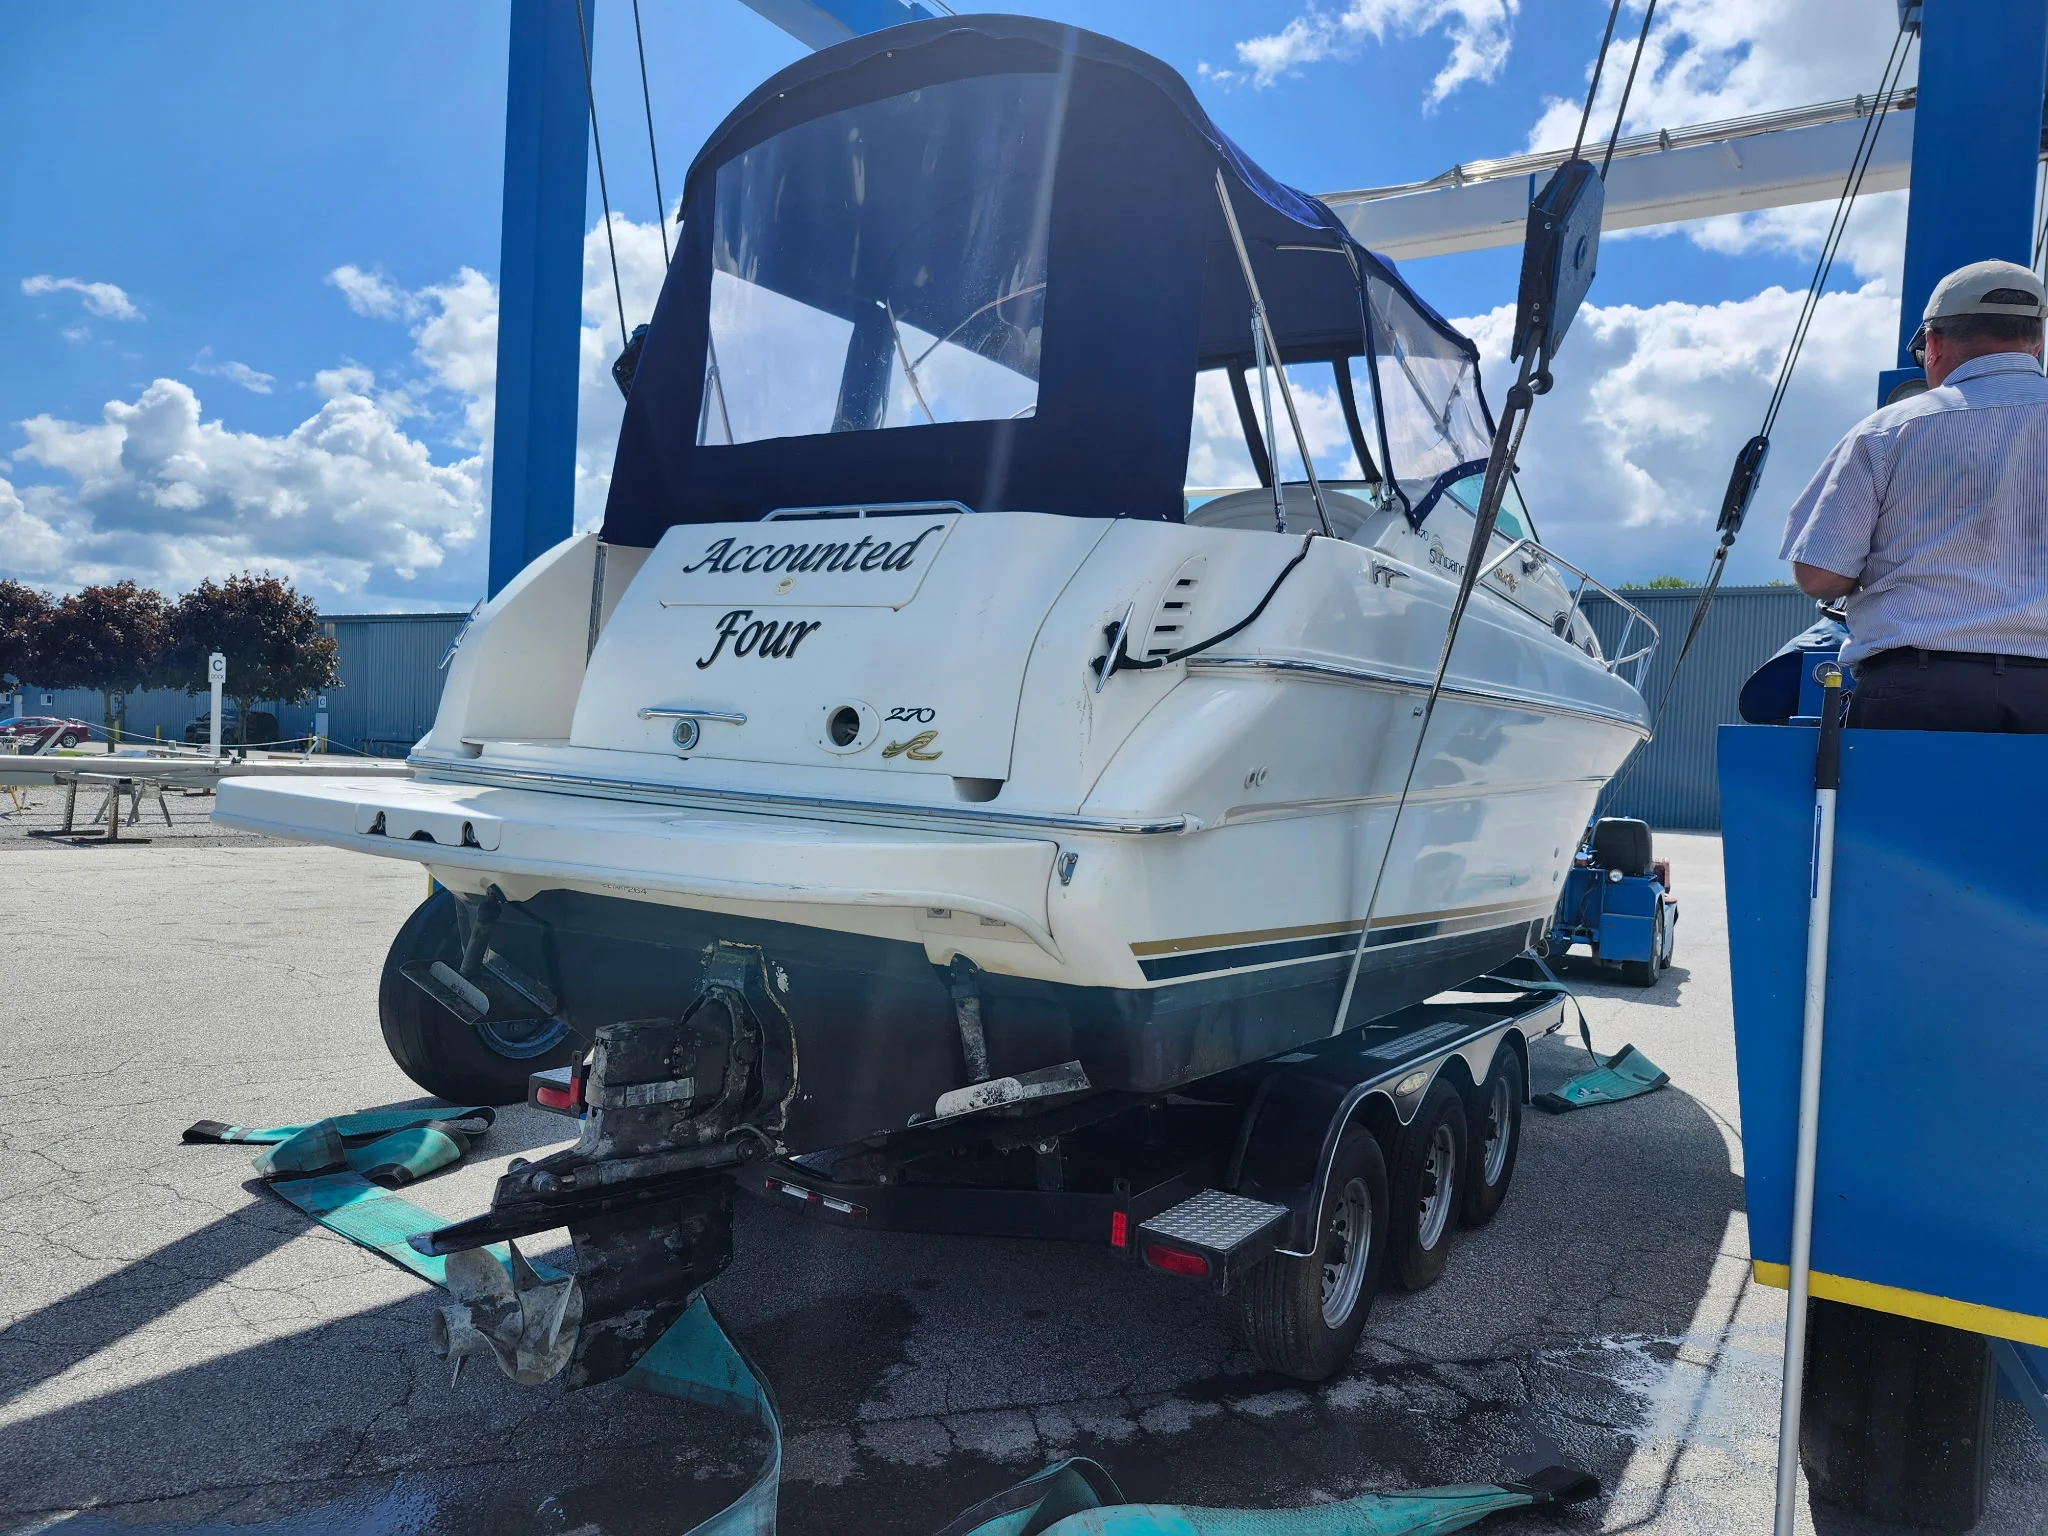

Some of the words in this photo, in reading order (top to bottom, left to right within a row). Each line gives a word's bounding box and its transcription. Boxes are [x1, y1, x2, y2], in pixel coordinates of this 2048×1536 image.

[683, 524, 945, 574] Accounted
[696, 609, 821, 670] Four
[212, 659, 223, 671] C
[884, 707, 936, 723] 270
